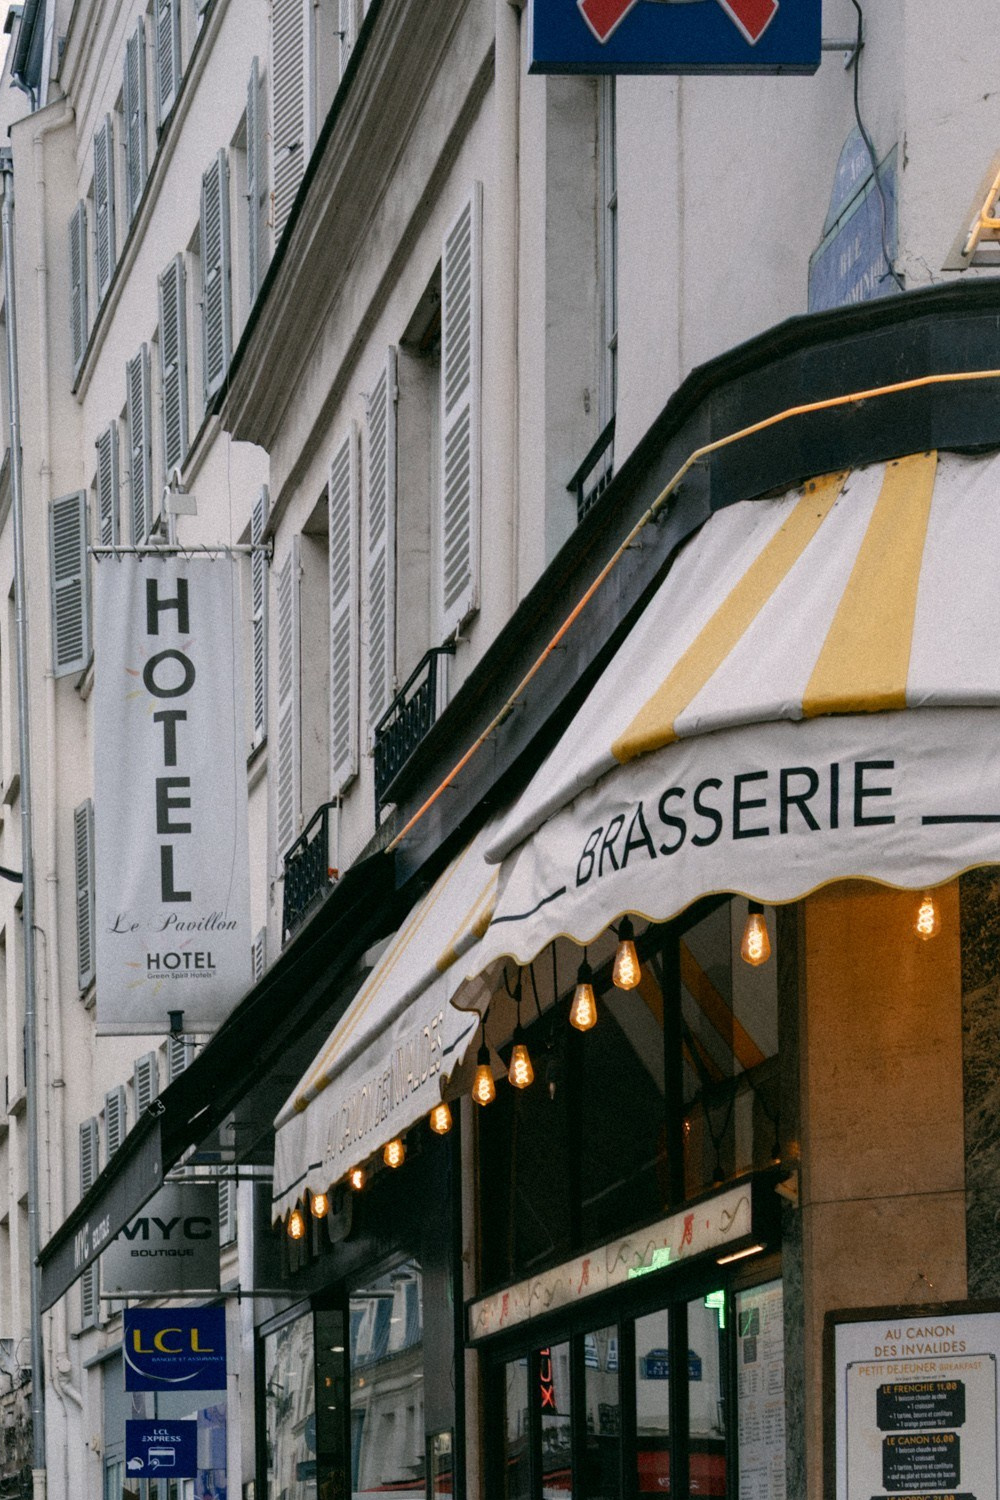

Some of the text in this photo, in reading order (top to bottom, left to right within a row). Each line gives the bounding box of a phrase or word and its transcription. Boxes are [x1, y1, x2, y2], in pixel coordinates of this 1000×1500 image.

[142, 577, 196, 903] HOTEL
[576, 759, 896, 888] BRASSERIE
[105, 911, 238, 934] Le Pavillon
[146, 951, 216, 970] HOTEL
[147, 972, 170, 980] Green
[113, 1216, 212, 1241] MYC
[74, 1222, 90, 1270] MYC
[130, 1249, 194, 1257] BOUTIQUE
[132, 1327, 215, 1354] LCL
[885, 1325, 955, 1340] AU CANON
[874, 1340, 966, 1358] DES INVALIDES
[858, 1365, 884, 1376] PETIT
[939, 1361, 982, 1371] BREAKFAST
[883, 1386, 891, 1394] LE
[894, 1384, 934, 1393] FRENCHIE
[887, 1438, 895, 1446] LE
[898, 1436, 929, 1445] CANON
